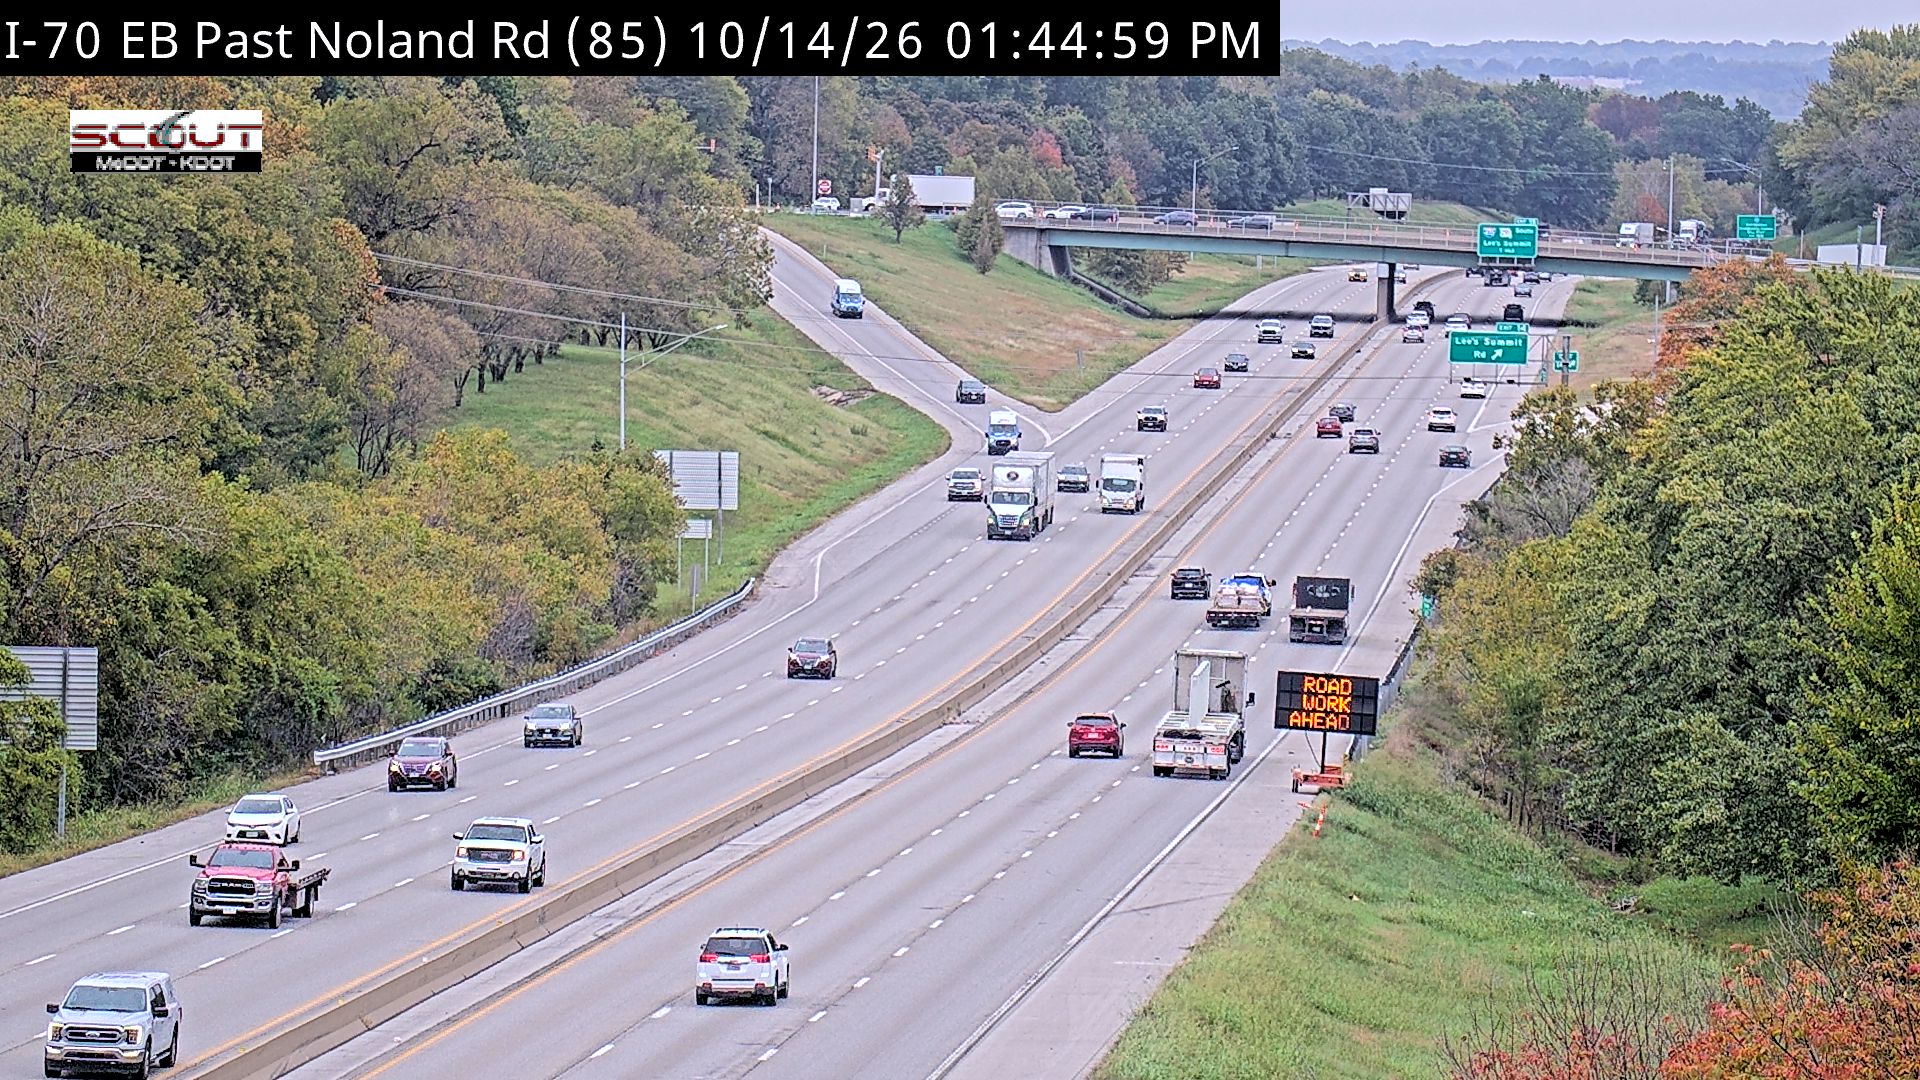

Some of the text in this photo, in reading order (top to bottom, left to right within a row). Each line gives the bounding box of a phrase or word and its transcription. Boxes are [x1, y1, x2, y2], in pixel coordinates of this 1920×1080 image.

[1454, 337, 1523, 347] Lee's Summit
[1473, 350, 1487, 359] Rd
[1303, 676, 1352, 695] ROAD
[1302, 694, 1352, 713] WORK
[1289, 711, 1350, 731] AHEAD
